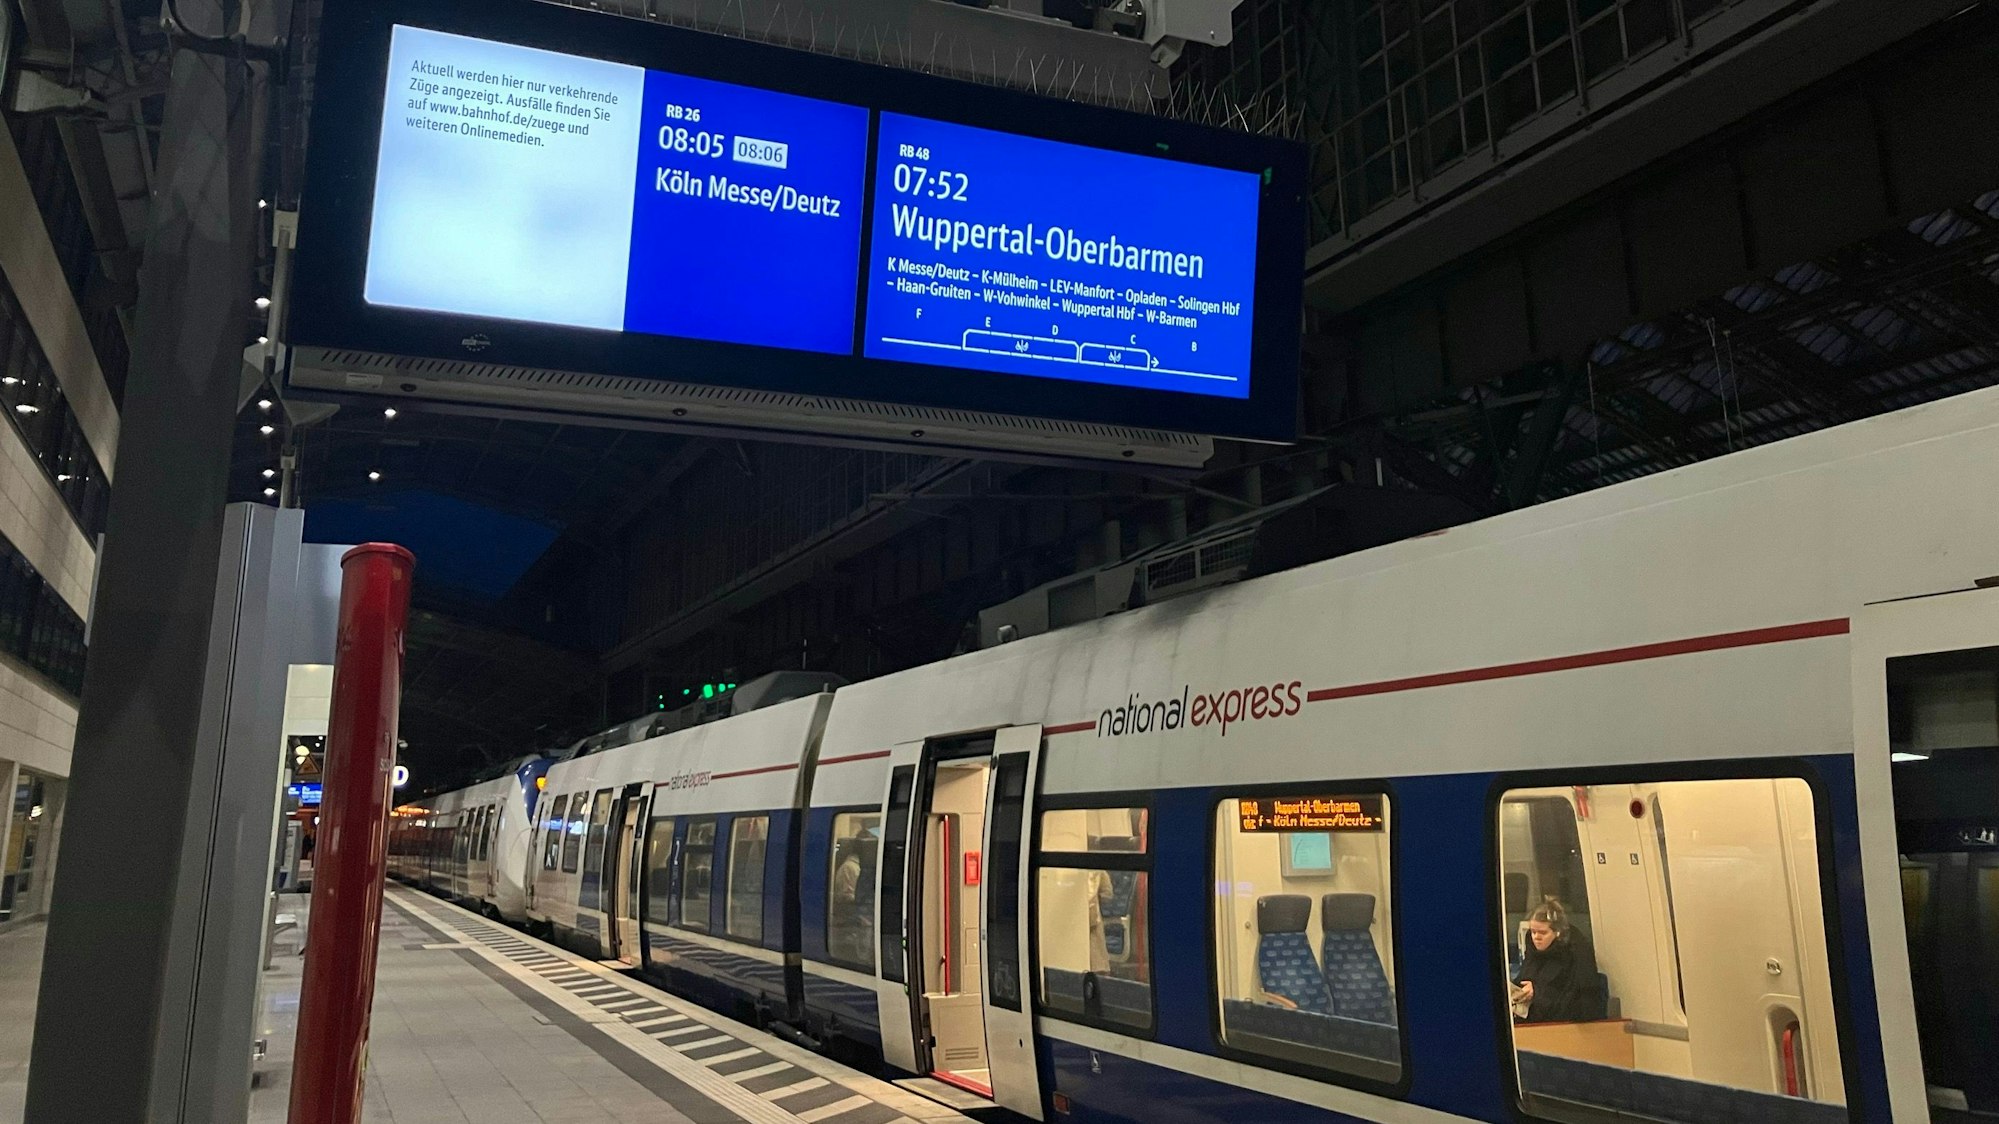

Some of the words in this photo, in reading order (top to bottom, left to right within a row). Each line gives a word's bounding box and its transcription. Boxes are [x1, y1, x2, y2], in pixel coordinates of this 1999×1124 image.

[409, 77, 439, 96] Züge
[442, 85, 503, 106] angezeigt.
[506, 93, 552, 112] Ausfälle
[555, 100, 591, 118] finden
[593, 107, 611, 121] Sie
[411, 60, 454, 78] Aktuell
[457, 68, 499, 85] werden
[502, 74, 525, 90] hier
[527, 80, 547, 93] nur
[549, 84, 618, 105] verkehrende
[406, 116, 458, 134] weiteren
[460, 122, 545, 147] Onlinemedien.
[407, 97, 428, 110] auf
[430, 102, 565, 134] www.bahnhof.de/zuege
[568, 124, 589, 136] und
[666, 104, 683, 119] RB
[684, 108, 701, 122] 26
[658, 125, 725, 158] 08:05
[738, 142, 783, 163] 08:06
[900, 143, 915, 158] RB
[915, 147, 930, 160] 48
[655, 166, 702, 197] Köln
[708, 175, 841, 218] Messe/Deutz
[893, 163, 969, 202] 07:52
[892, 203, 1203, 279] Wuppertal-Oberbarmen
[887, 257, 897, 272] K
[898, 258, 970, 282] Messe/Deutz
[981, 269, 1038, 291] K-Mülheim
[1050, 278, 1115, 300] LEV-Manfort
[1125, 288, 1167, 307] Opladen
[1178, 295, 1220, 315] Solingen
[1222, 301, 1240, 316] Hbf
[896, 277, 971, 300] Haan-Gruiten
[983, 288, 1051, 311] W-Vohwinkel
[1062, 298, 1115, 319] Wuppertal
[1116, 306, 1136, 321] Hbf
[1146, 309, 1197, 329] W-Barmen
[915, 308, 922, 319] F
[985, 317, 991, 327] E
[1051, 325, 1059, 335] D
[1130, 334, 1136, 345] C
[1191, 341, 1197, 352] B
[1098, 684, 1189, 738] national
[1191, 680, 1302, 737] express
[393, 766, 409, 786] D
[1273, 814, 1298, 827] Köln
[1300, 813, 1372, 827] Messe/Deutz
